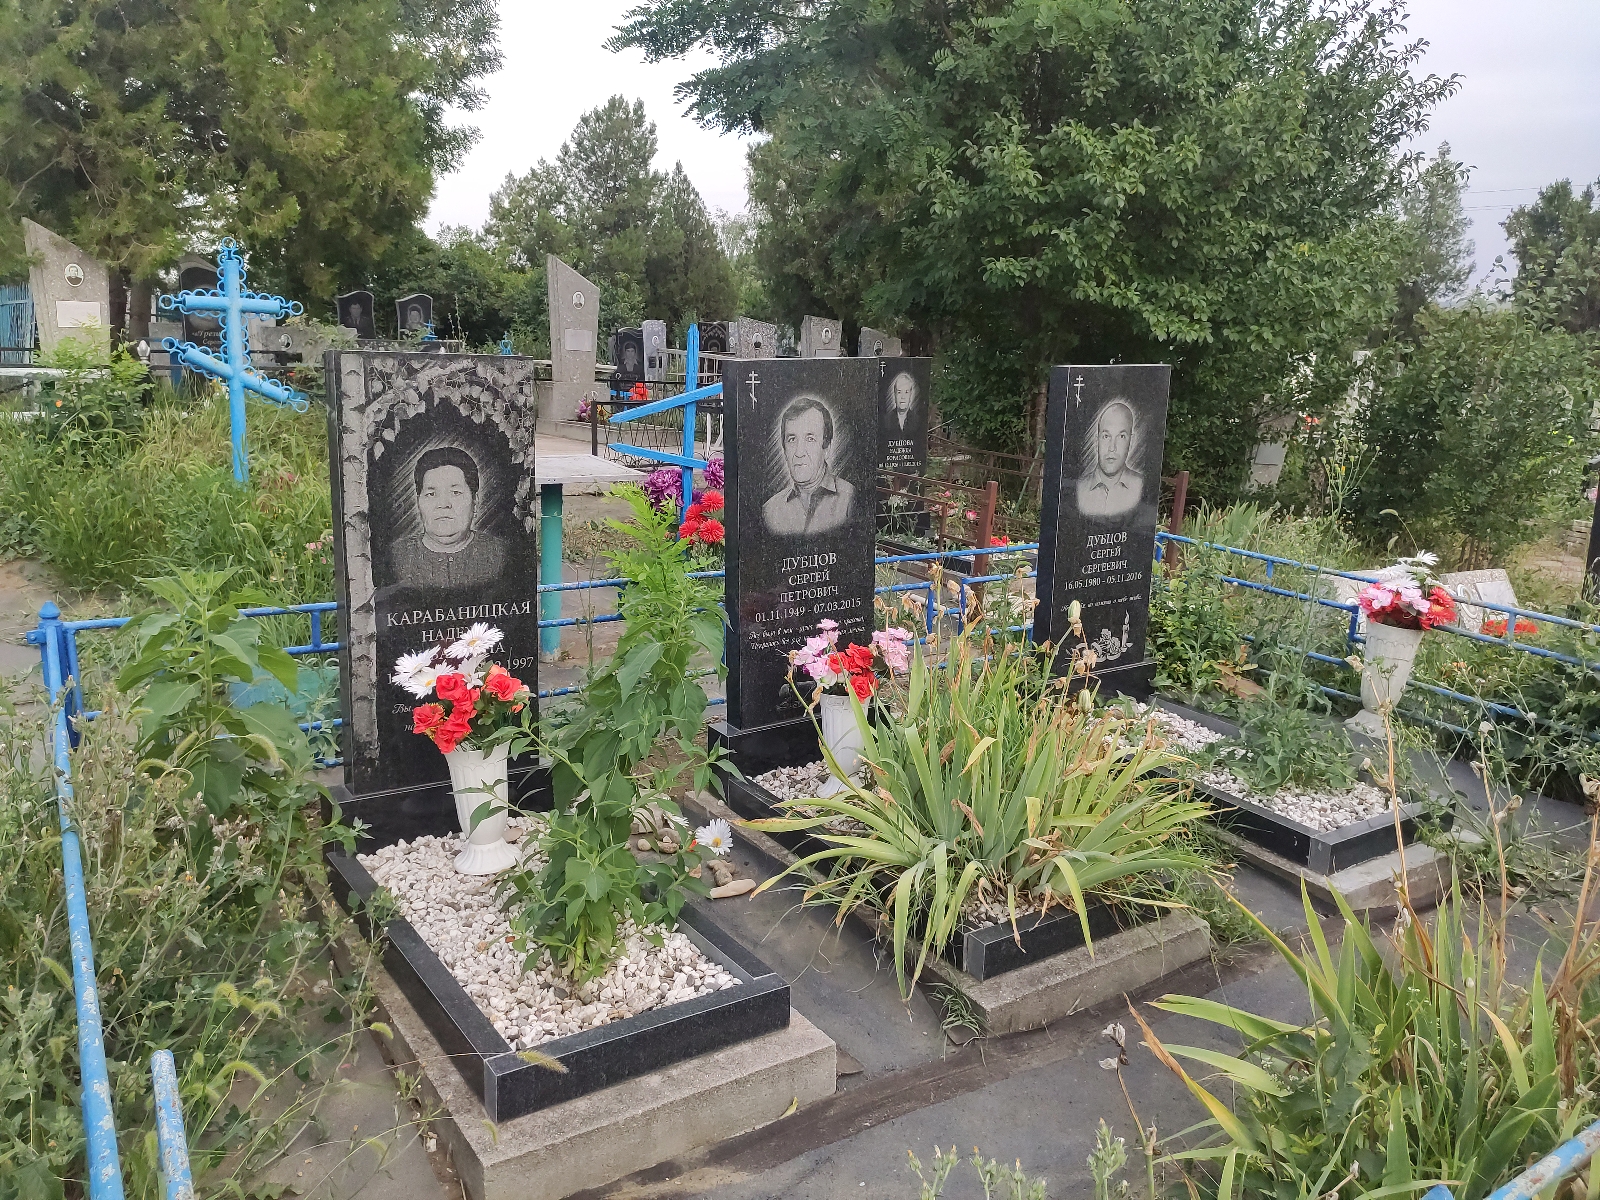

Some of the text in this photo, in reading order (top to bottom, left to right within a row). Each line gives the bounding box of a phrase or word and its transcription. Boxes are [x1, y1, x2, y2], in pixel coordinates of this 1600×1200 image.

[1086, 531, 1127, 548] ДУБЦОВ
[1090, 546, 1121, 559] СЕРГЕЙ
[781, 552, 837, 573] ДУБЦОВ
[1081, 560, 1128, 574] СЕРГЕЕВИЧ
[788, 569, 830, 585] СЕРГЕЙ
[780, 585, 839, 602] ПЕТРОВИЧ
[386, 600, 532, 627] КАРАБАНИЦКАЯ
[755, 606, 805, 622] 01.11.1949
[813, 598, 861, 614] 07.03.2015
[421, 624, 500, 642] НАДЕ
